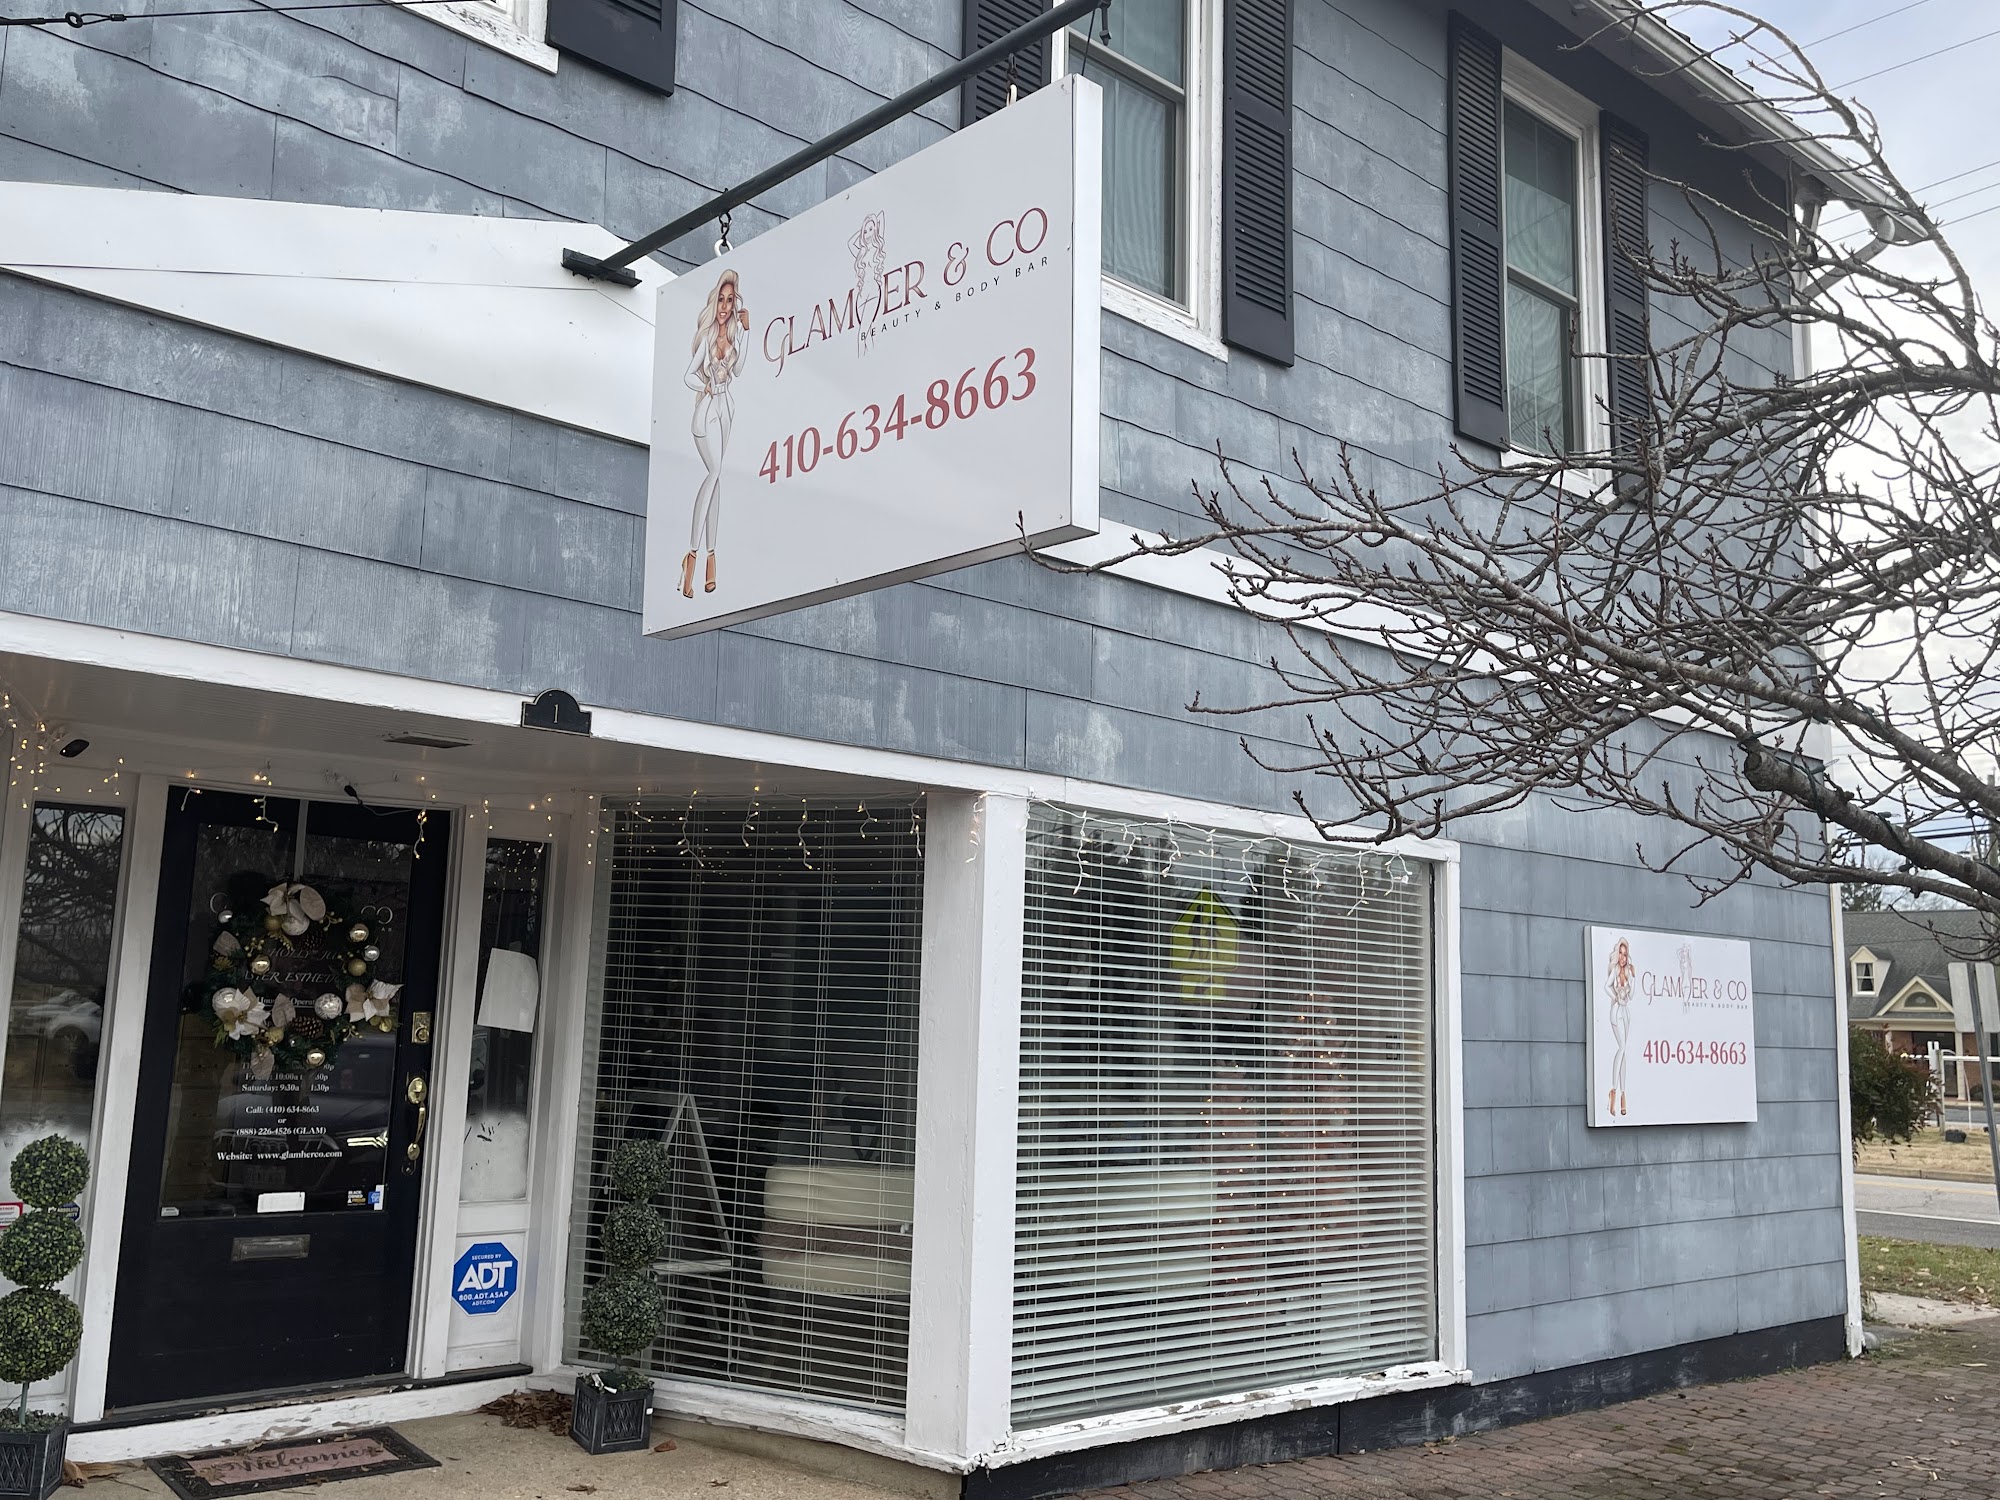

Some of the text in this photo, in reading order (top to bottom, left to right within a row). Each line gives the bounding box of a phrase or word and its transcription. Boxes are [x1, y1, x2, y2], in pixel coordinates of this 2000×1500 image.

[943, 242, 969, 286] &
[986, 207, 1048, 266] CO
[860, 256, 1049, 341] BEAUTY & BODY BAR
[759, 347, 1037, 484] 410-634-8663
[553, 703, 559, 723] 1
[1713, 979, 1722, 999] &
[1727, 980, 1747, 1001] CO
[291, 997, 315, 1006] Operat
[1643, 1040, 1747, 1065] 410-634-8663
[241, 1083, 279, 1093] Saturday:
[245, 1105, 320, 1114] Call: (410) 634-8663
[236, 1127, 327, 1136] (888) 226-4526 (GLAM)
[217, 1150, 343, 1161] Website: www.glamherco.com
[457, 1261, 513, 1292] ADT
[458, 1291, 509, 1301] 800.ADT.ASAP
